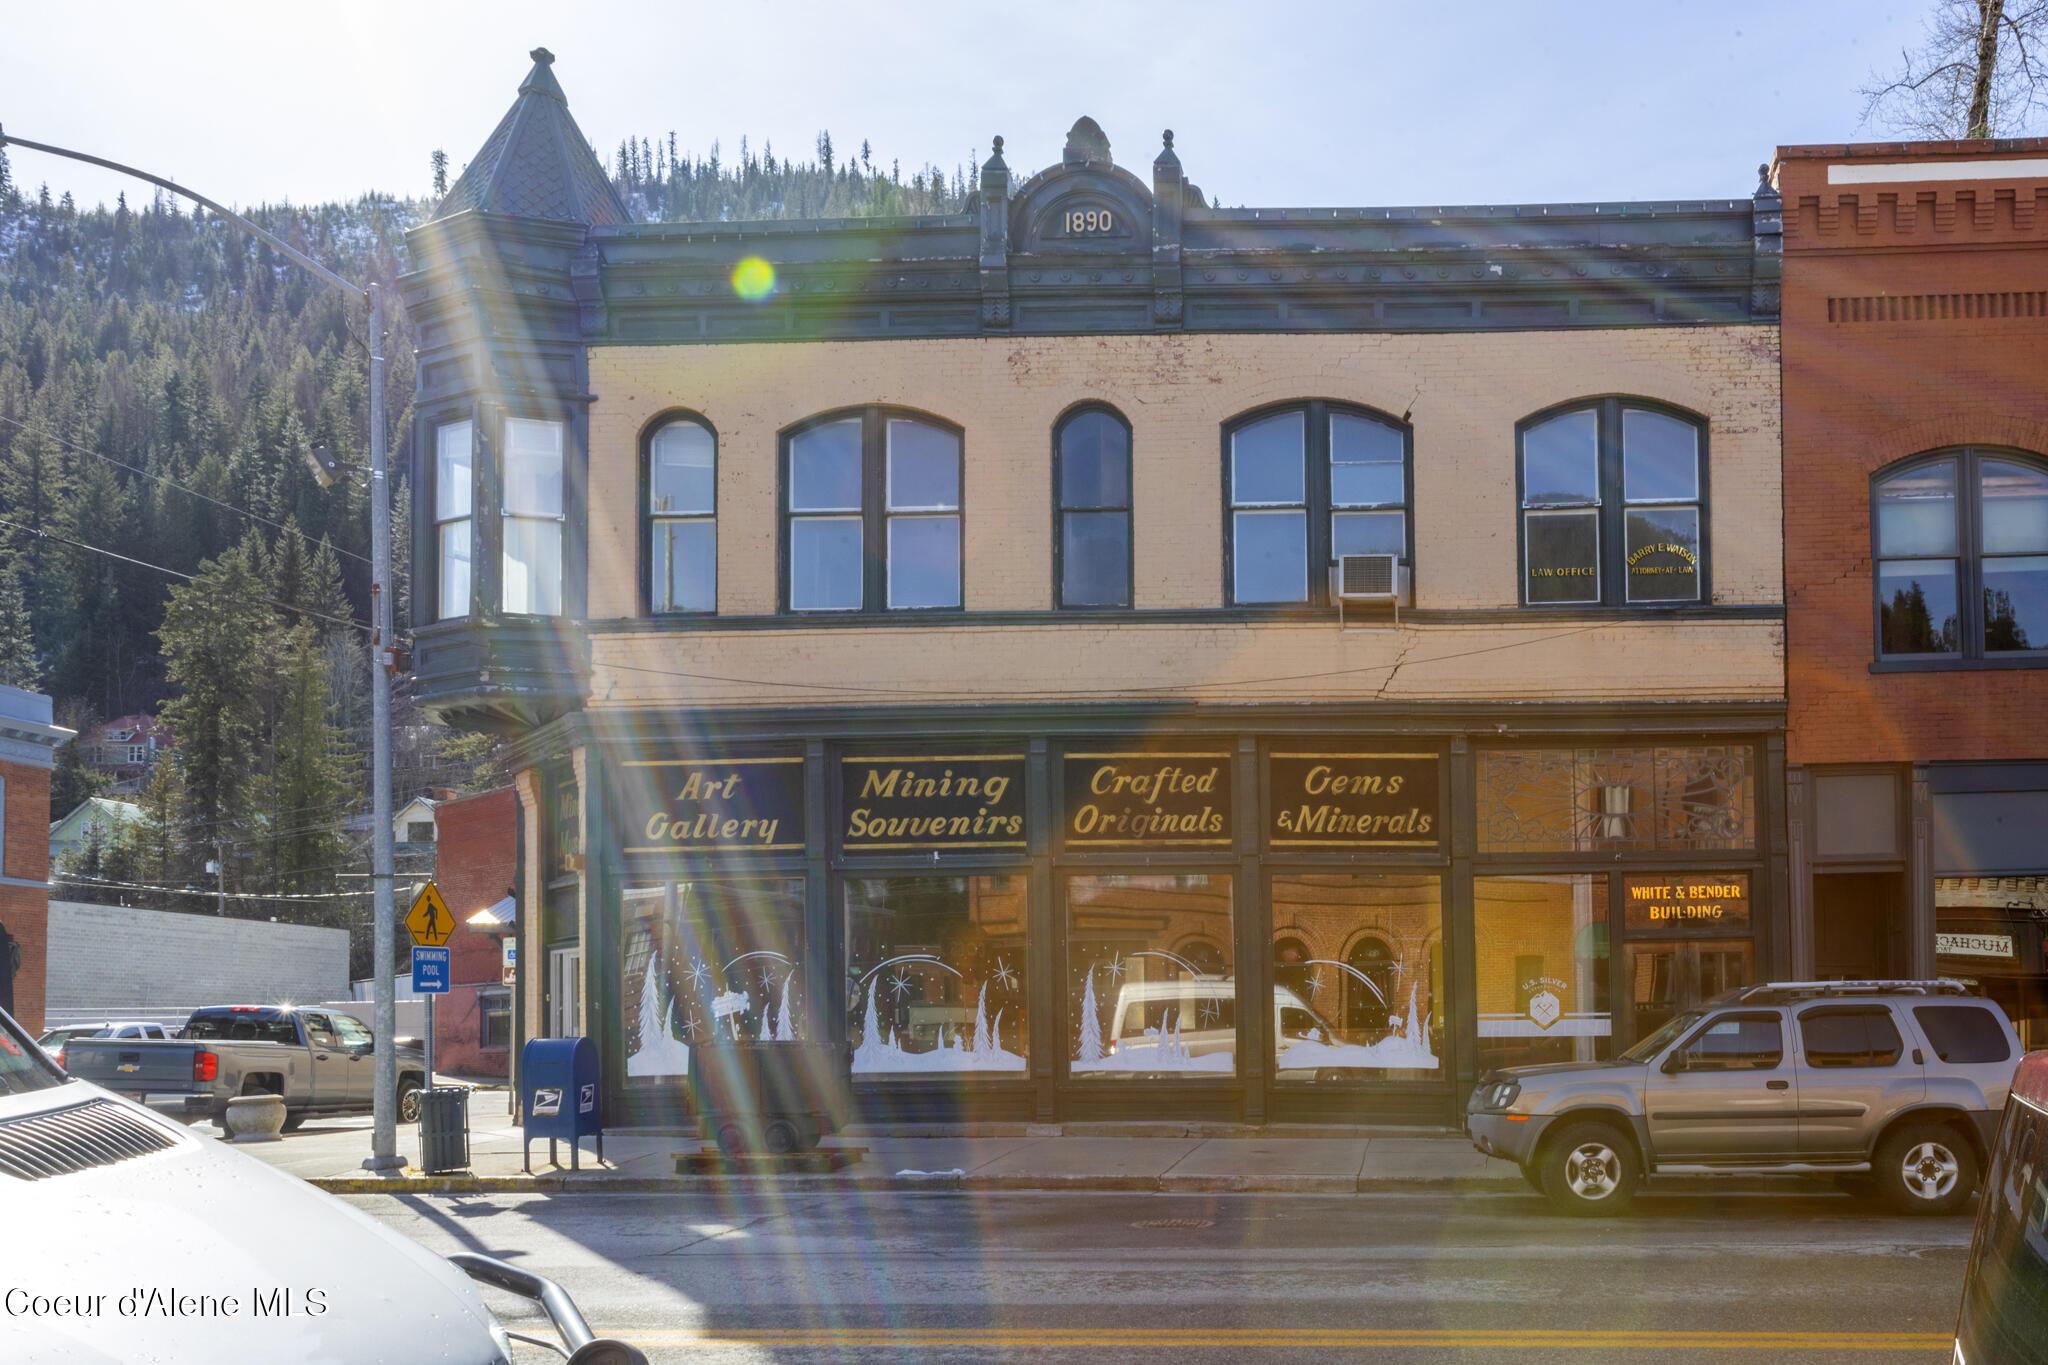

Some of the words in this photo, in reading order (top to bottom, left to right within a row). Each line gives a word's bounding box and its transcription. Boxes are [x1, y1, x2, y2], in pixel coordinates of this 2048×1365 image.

[1065, 210, 1112, 233] 1890
[1666, 544, 1697, 565] WATSON
[1531, 568, 1552, 577] LAW
[1556, 567, 1595, 576] OFFICE
[676, 772, 742, 801] Art
[860, 769, 1010, 805] Mining
[1091, 766, 1218, 804] Crafted
[1305, 765, 1404, 795] Gems
[645, 812, 779, 844] Gallery
[848, 807, 1023, 838] Souvenirs
[1074, 804, 1223, 838] Originals
[1631, 886, 1671, 899] WHITE
[1675, 886, 1685, 899] &
[1689, 885, 1740, 898] BENDER
[1650, 905, 1723, 919] BUILDING
[415, 951, 447, 962] SWIMMING
[422, 964, 440, 976] POOL
[1540, 976, 1568, 990] SILVER
